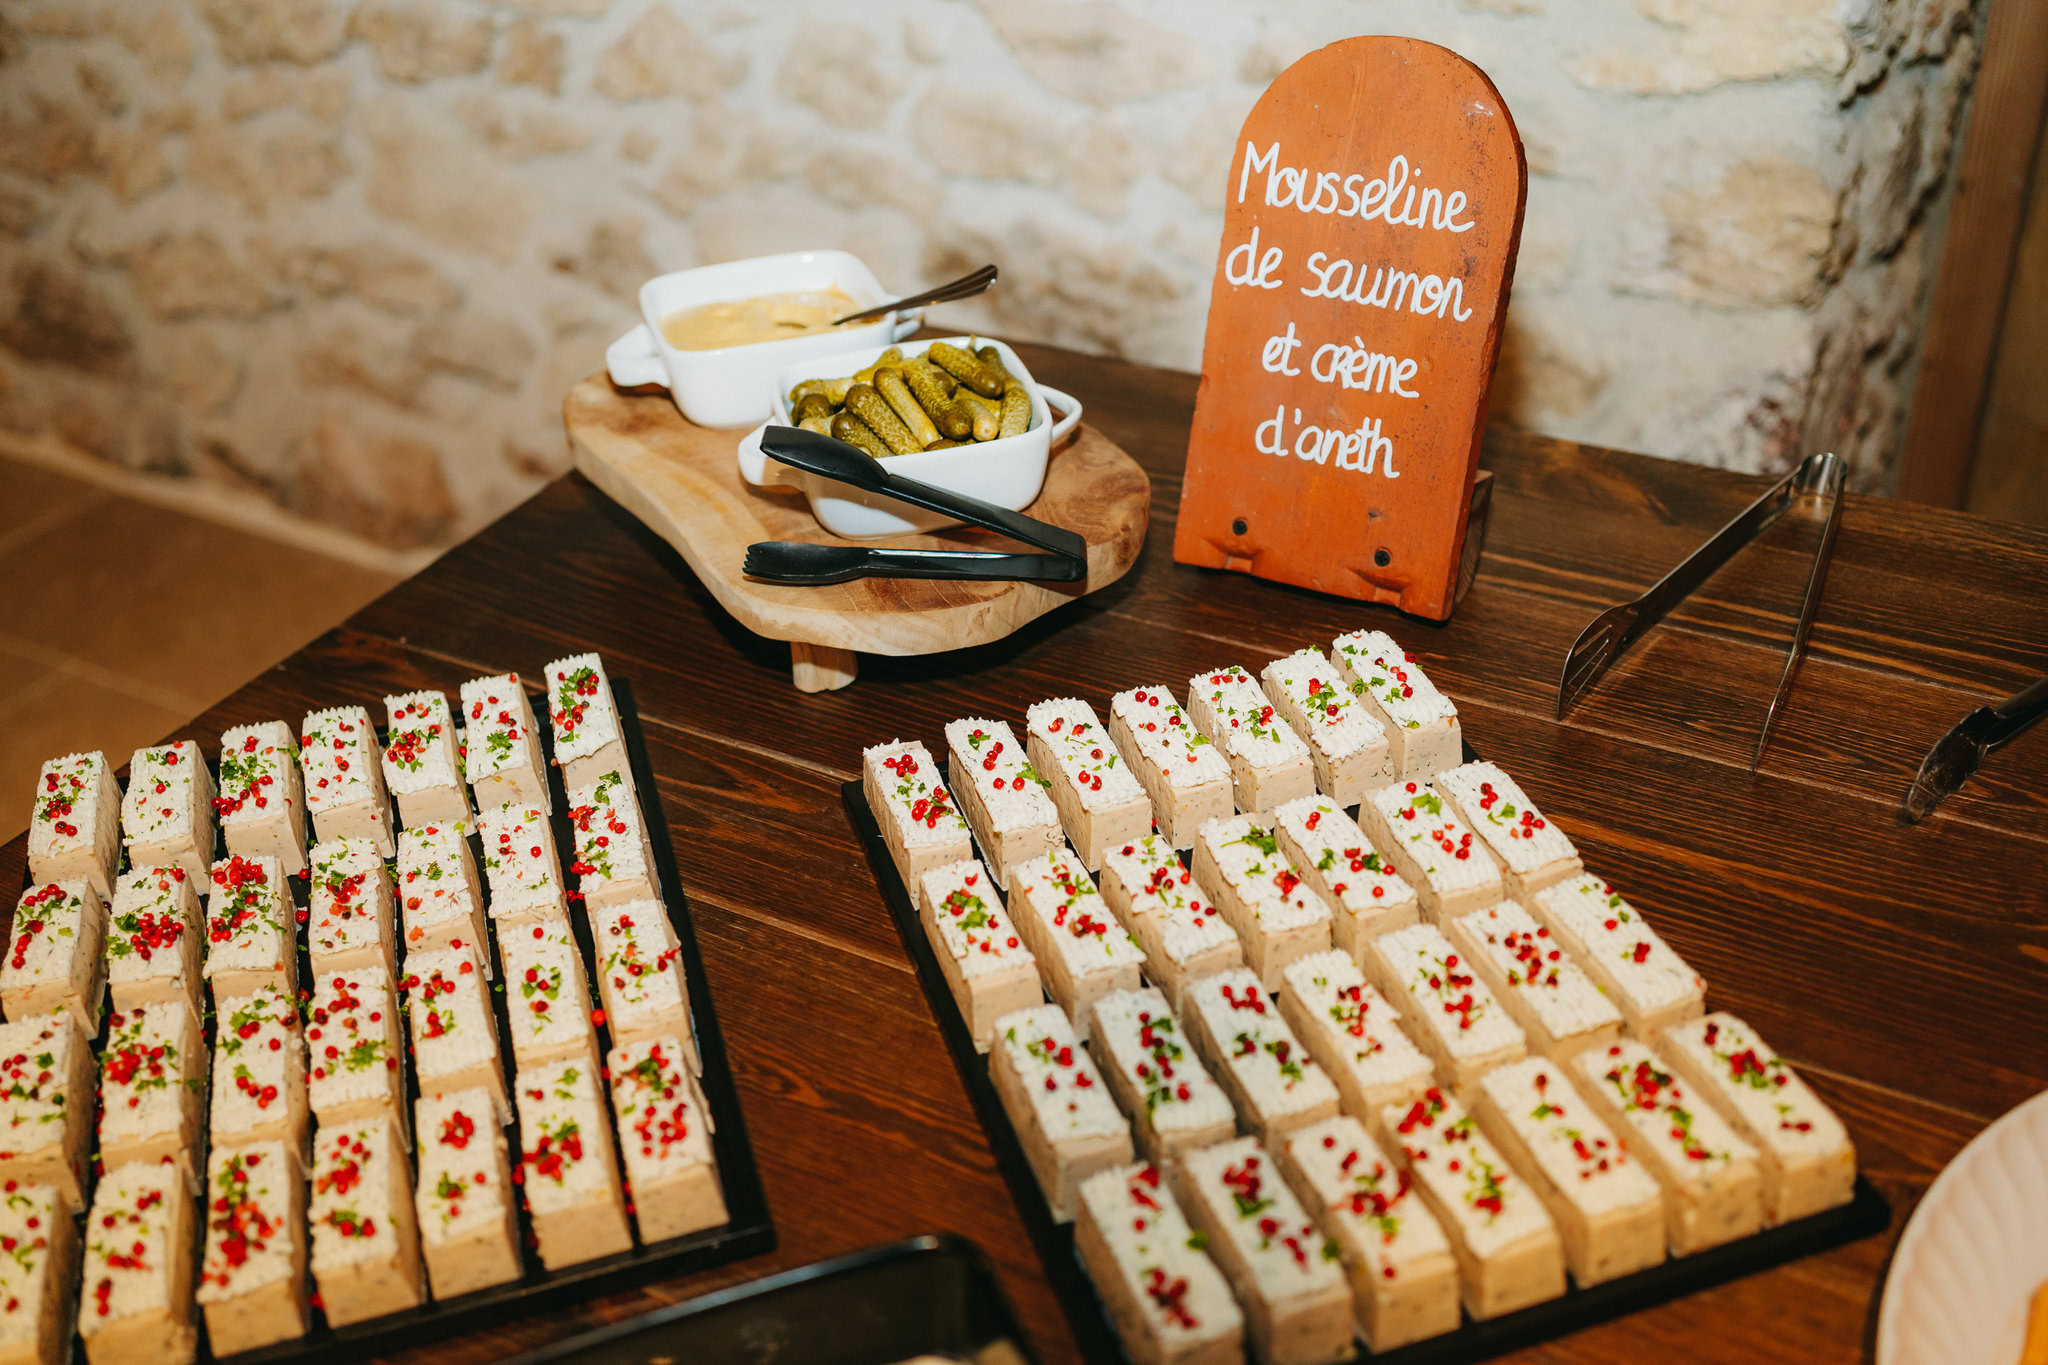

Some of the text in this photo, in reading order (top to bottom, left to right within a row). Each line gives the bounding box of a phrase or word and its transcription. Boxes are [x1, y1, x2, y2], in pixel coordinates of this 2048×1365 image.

[1237, 140, 1476, 233] Mousseline
[1224, 225, 1473, 322] de saumon
[1261, 321, 1420, 398] et crème
[1254, 404, 1401, 479] d'aneth
